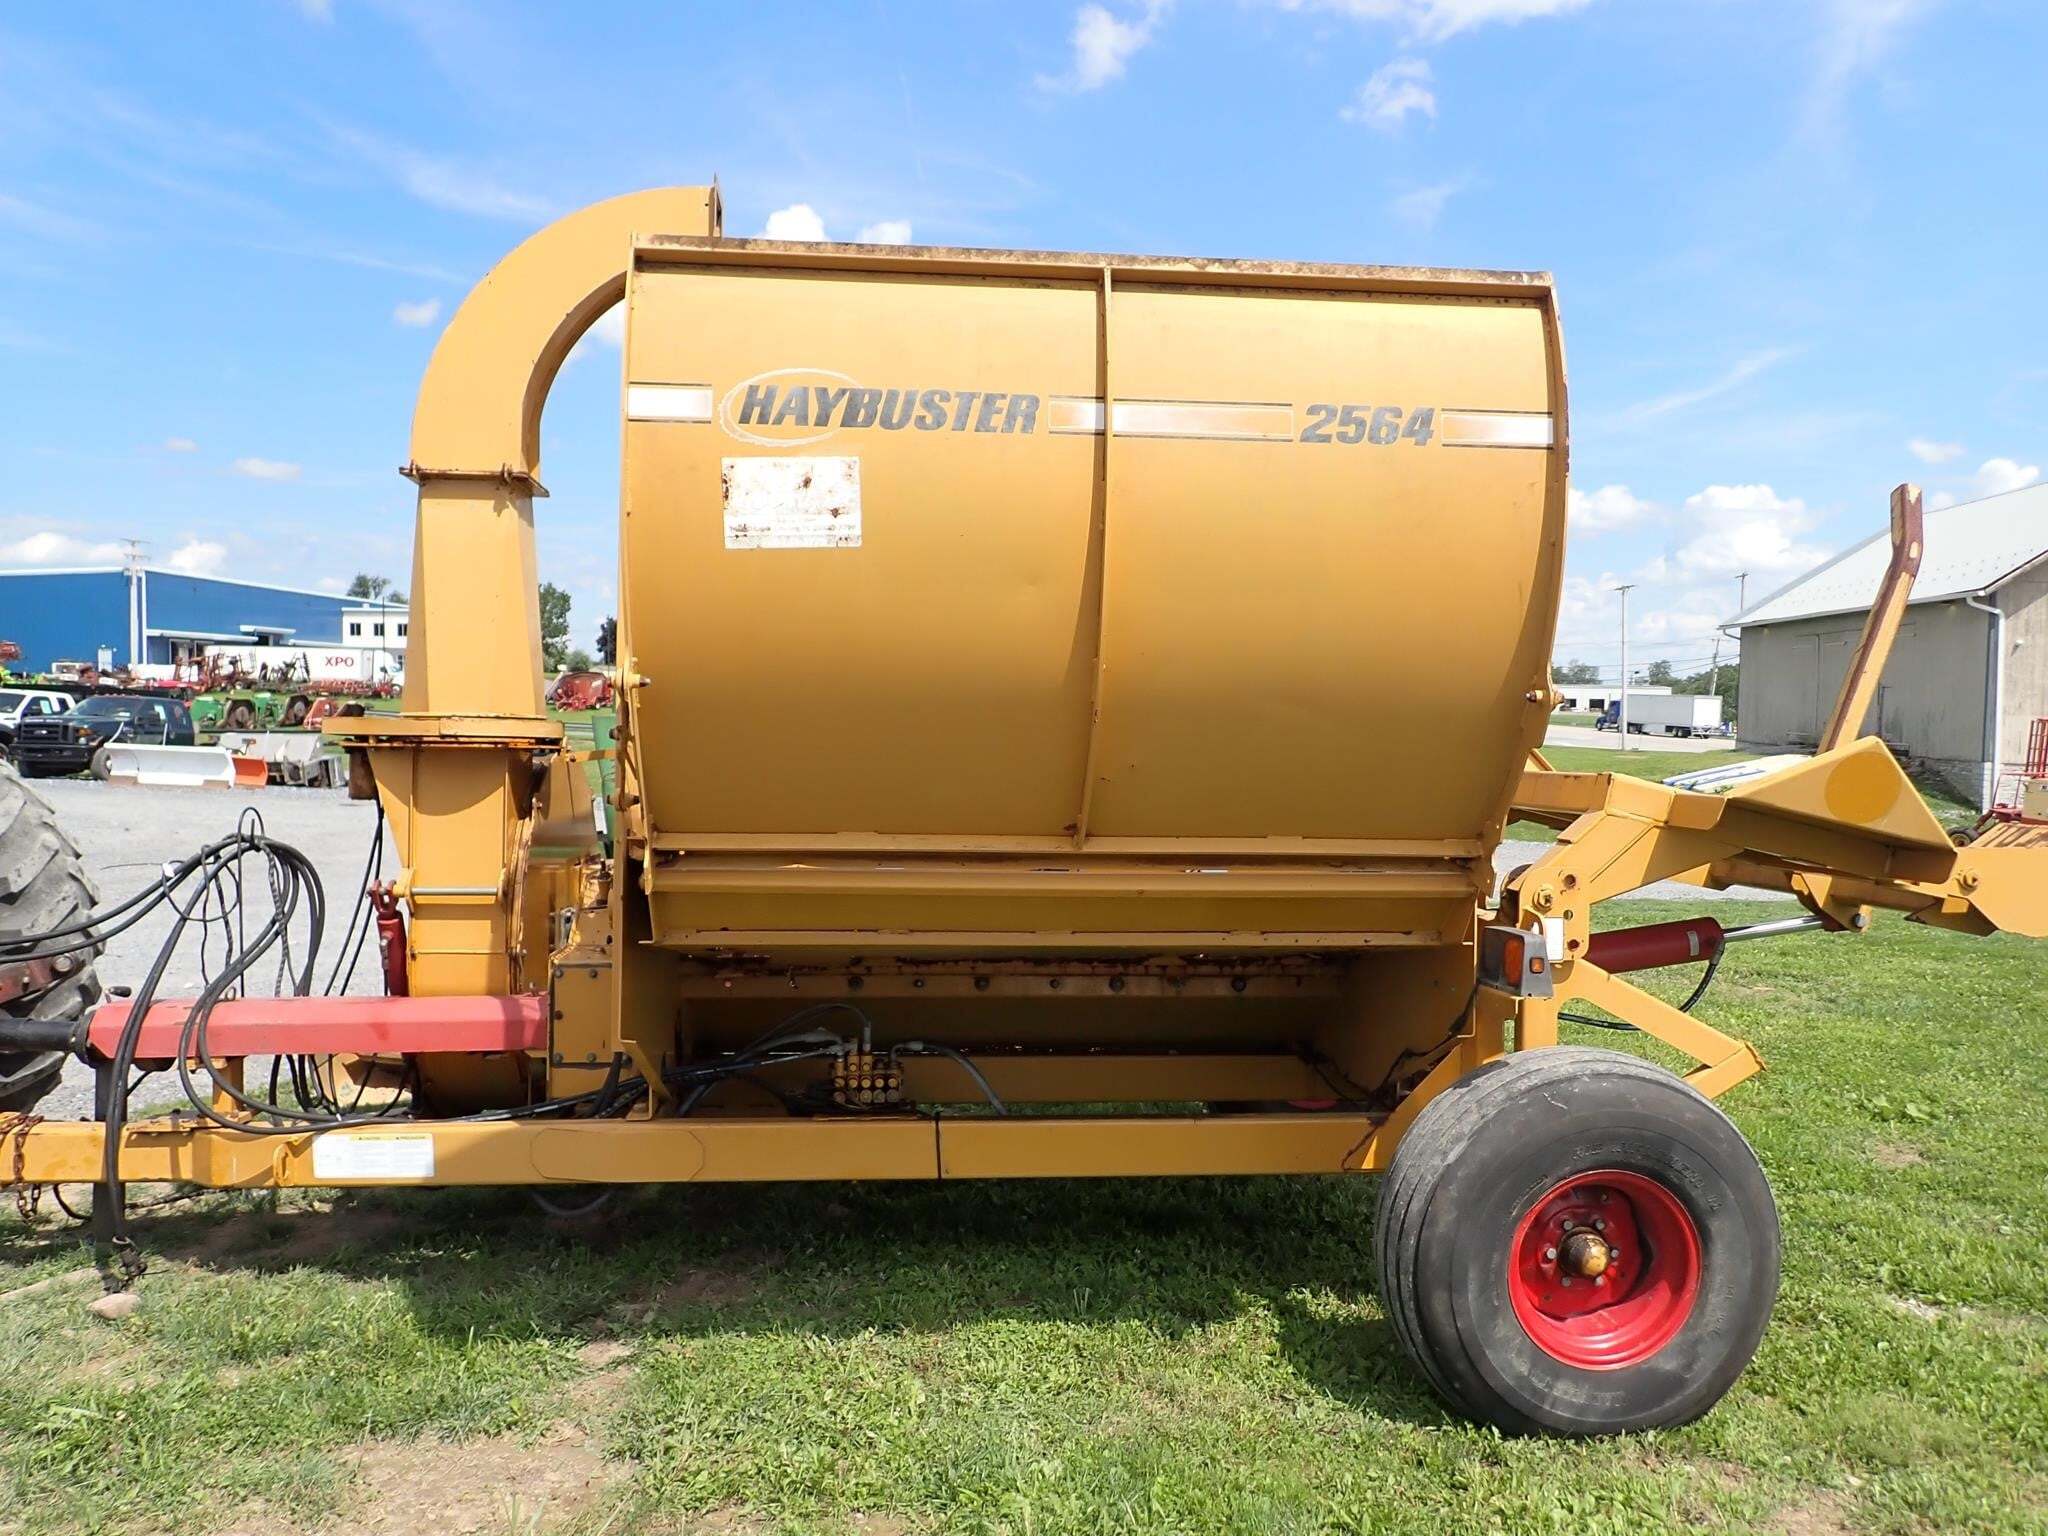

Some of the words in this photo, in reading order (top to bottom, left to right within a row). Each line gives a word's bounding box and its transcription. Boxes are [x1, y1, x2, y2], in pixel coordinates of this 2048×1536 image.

[738, 384, 1041, 434] HAYBUSTER
[1300, 403, 1435, 446] 2564
[325, 656, 354, 667] XPO
